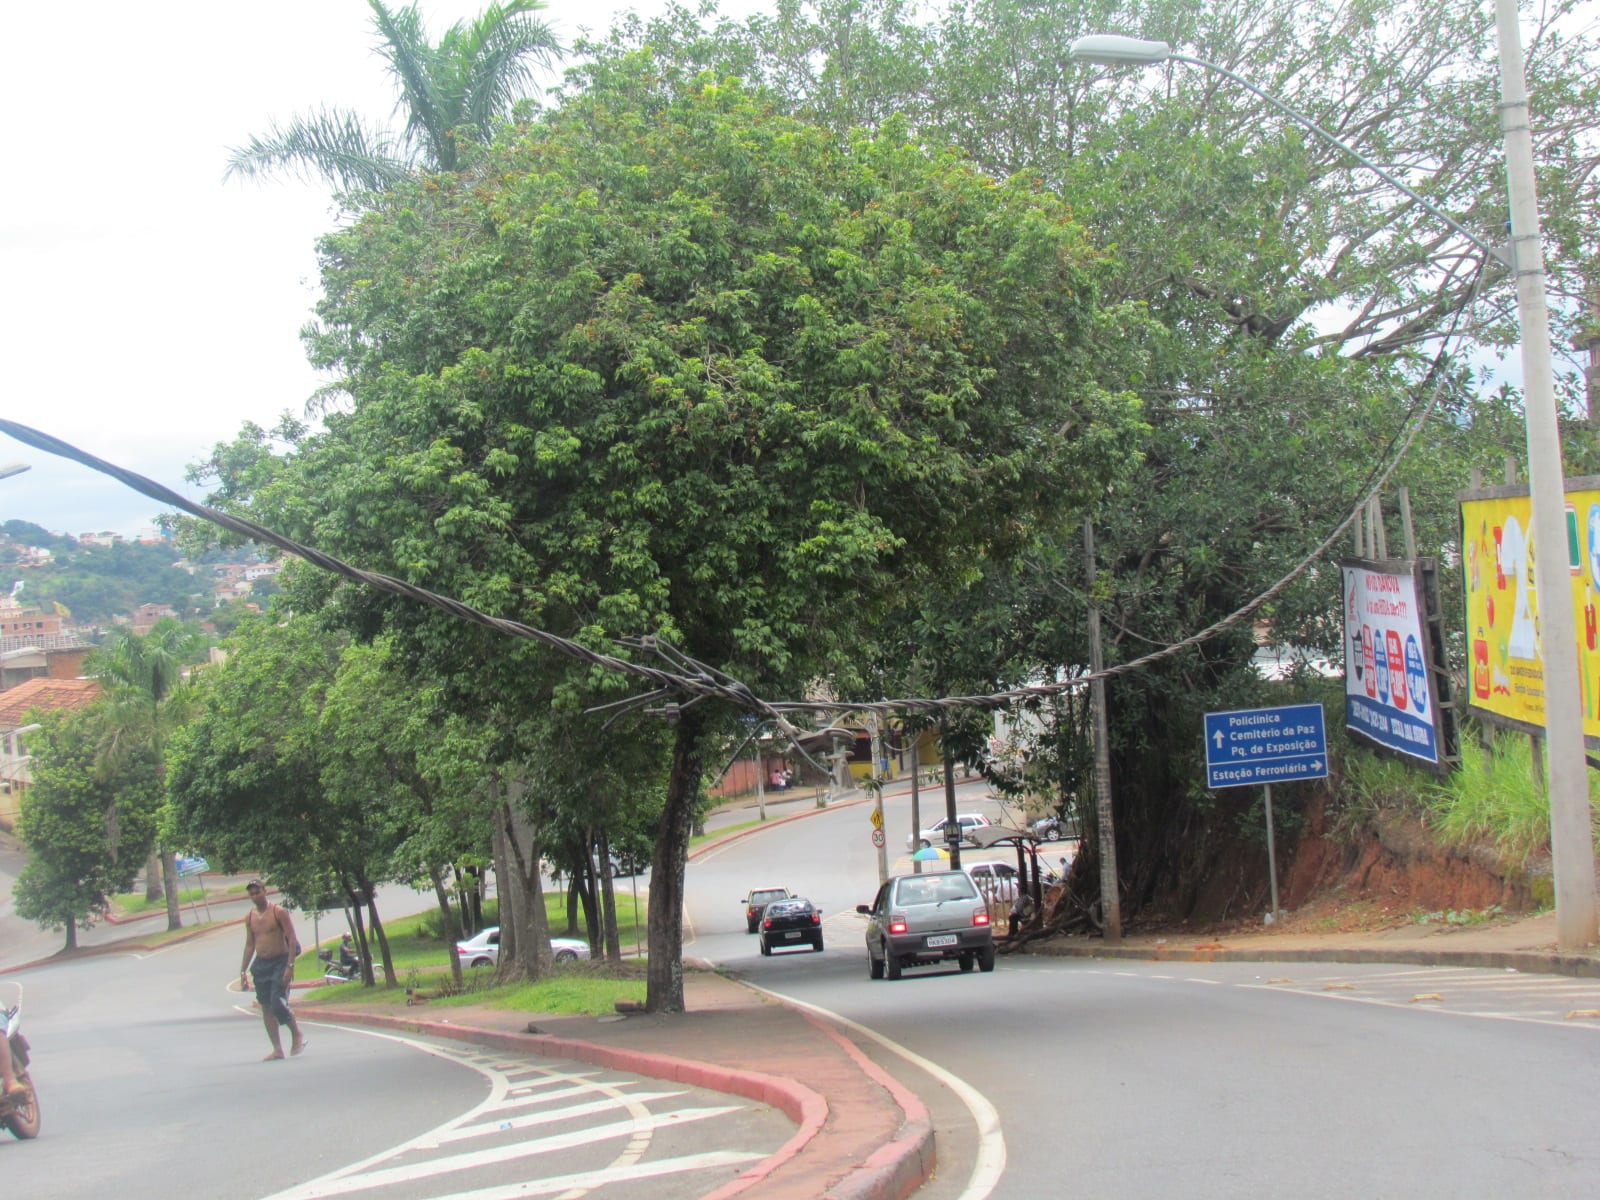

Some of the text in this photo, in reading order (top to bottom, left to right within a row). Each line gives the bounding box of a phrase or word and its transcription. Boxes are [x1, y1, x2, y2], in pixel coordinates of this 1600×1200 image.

[1230, 725, 1315, 740] Cemitério da Paz
[1231, 740, 1317, 757] Pq. de Exposição
[1213, 764, 1307, 781] Estação Ferroviária
